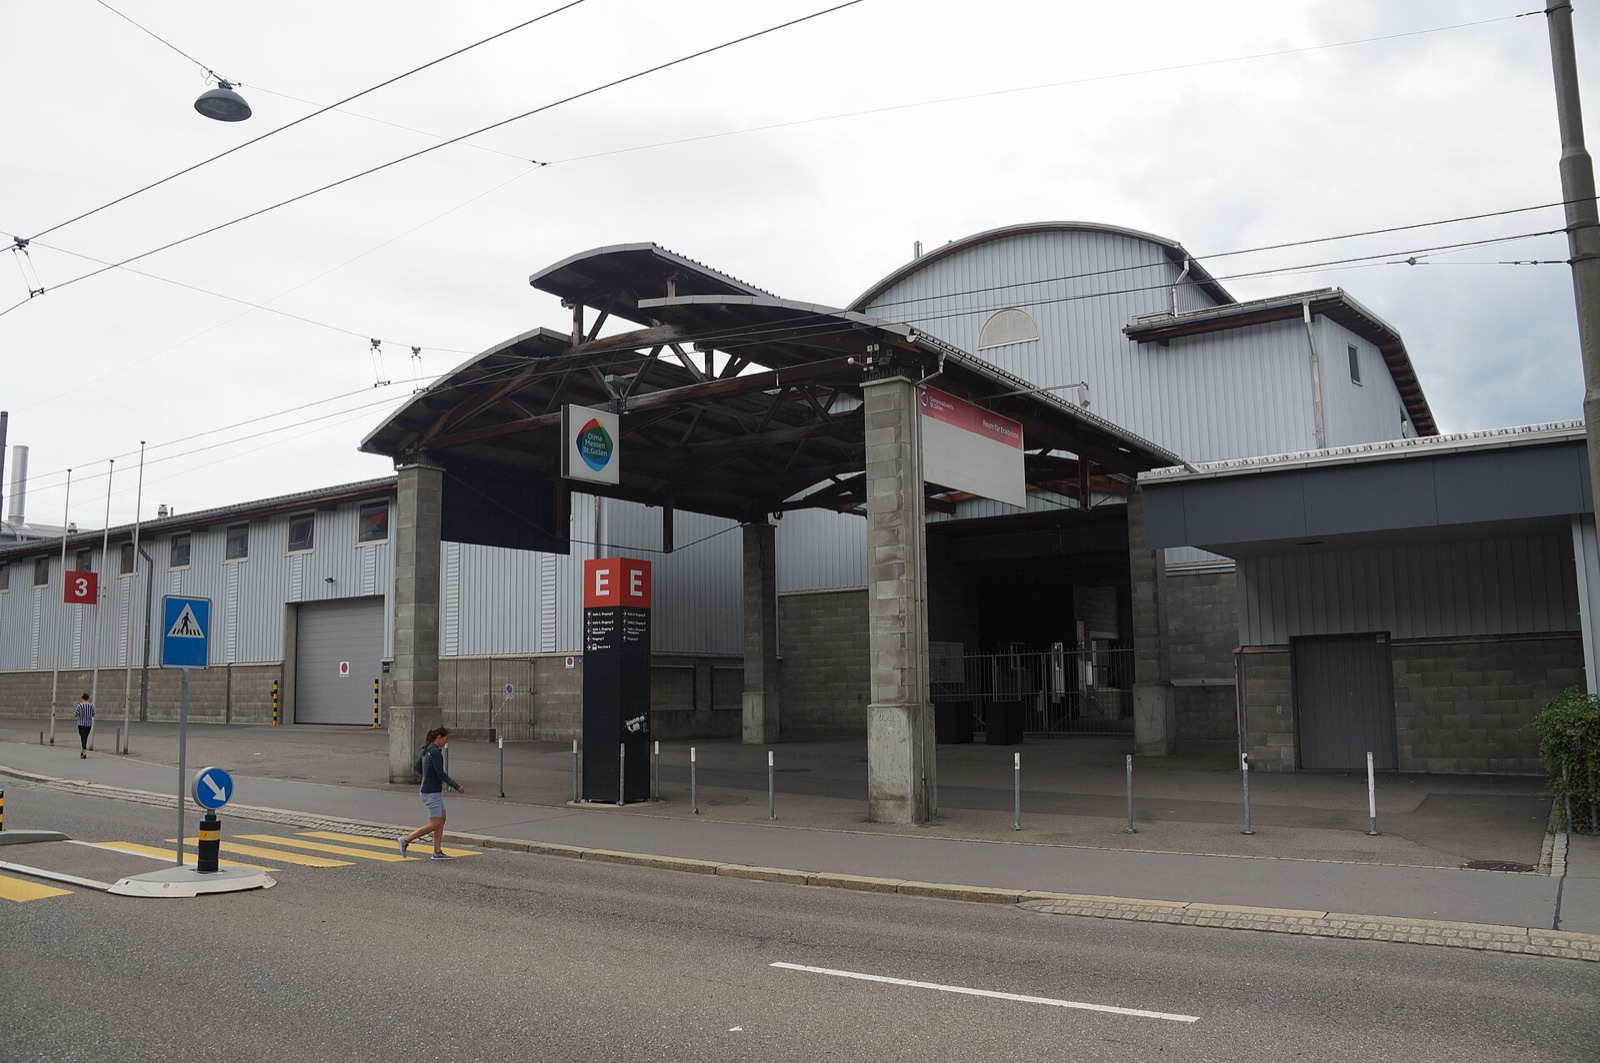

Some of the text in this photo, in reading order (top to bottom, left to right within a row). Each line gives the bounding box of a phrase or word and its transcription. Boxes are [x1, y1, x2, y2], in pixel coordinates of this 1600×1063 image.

[587, 433, 603, 442] Olma
[982, 420, 994, 431] Raum
[1001, 426, 1019, 440] Erlebnisse
[585, 439, 606, 449] Messen
[75, 577, 88, 597] 3
[595, 569, 610, 597] E
[630, 569, 643, 597] E
